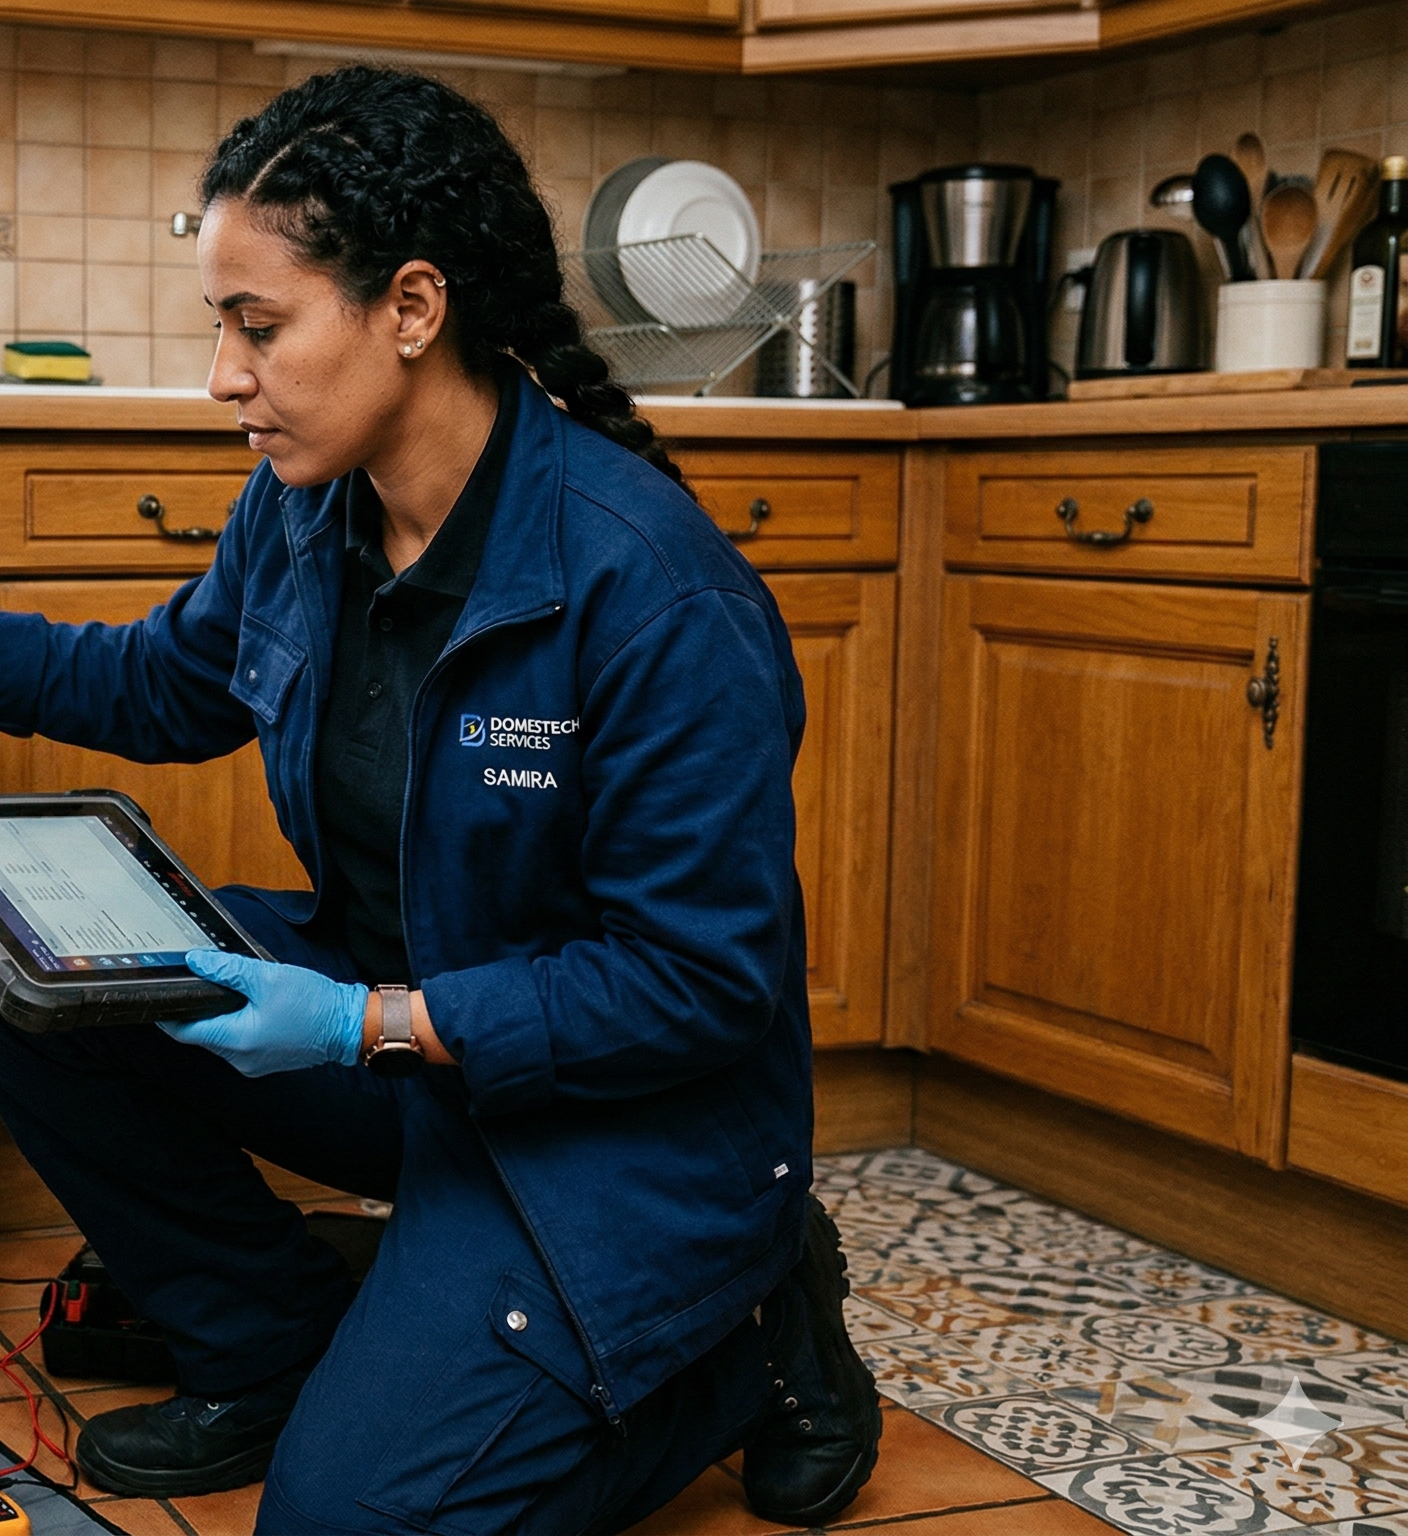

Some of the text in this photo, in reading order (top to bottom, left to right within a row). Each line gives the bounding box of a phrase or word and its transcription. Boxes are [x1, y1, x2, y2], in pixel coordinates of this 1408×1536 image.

[490, 716, 580, 735] DOMESTECH
[489, 733, 551, 750] SERVICES
[483, 767, 558, 789] SAMIRA
